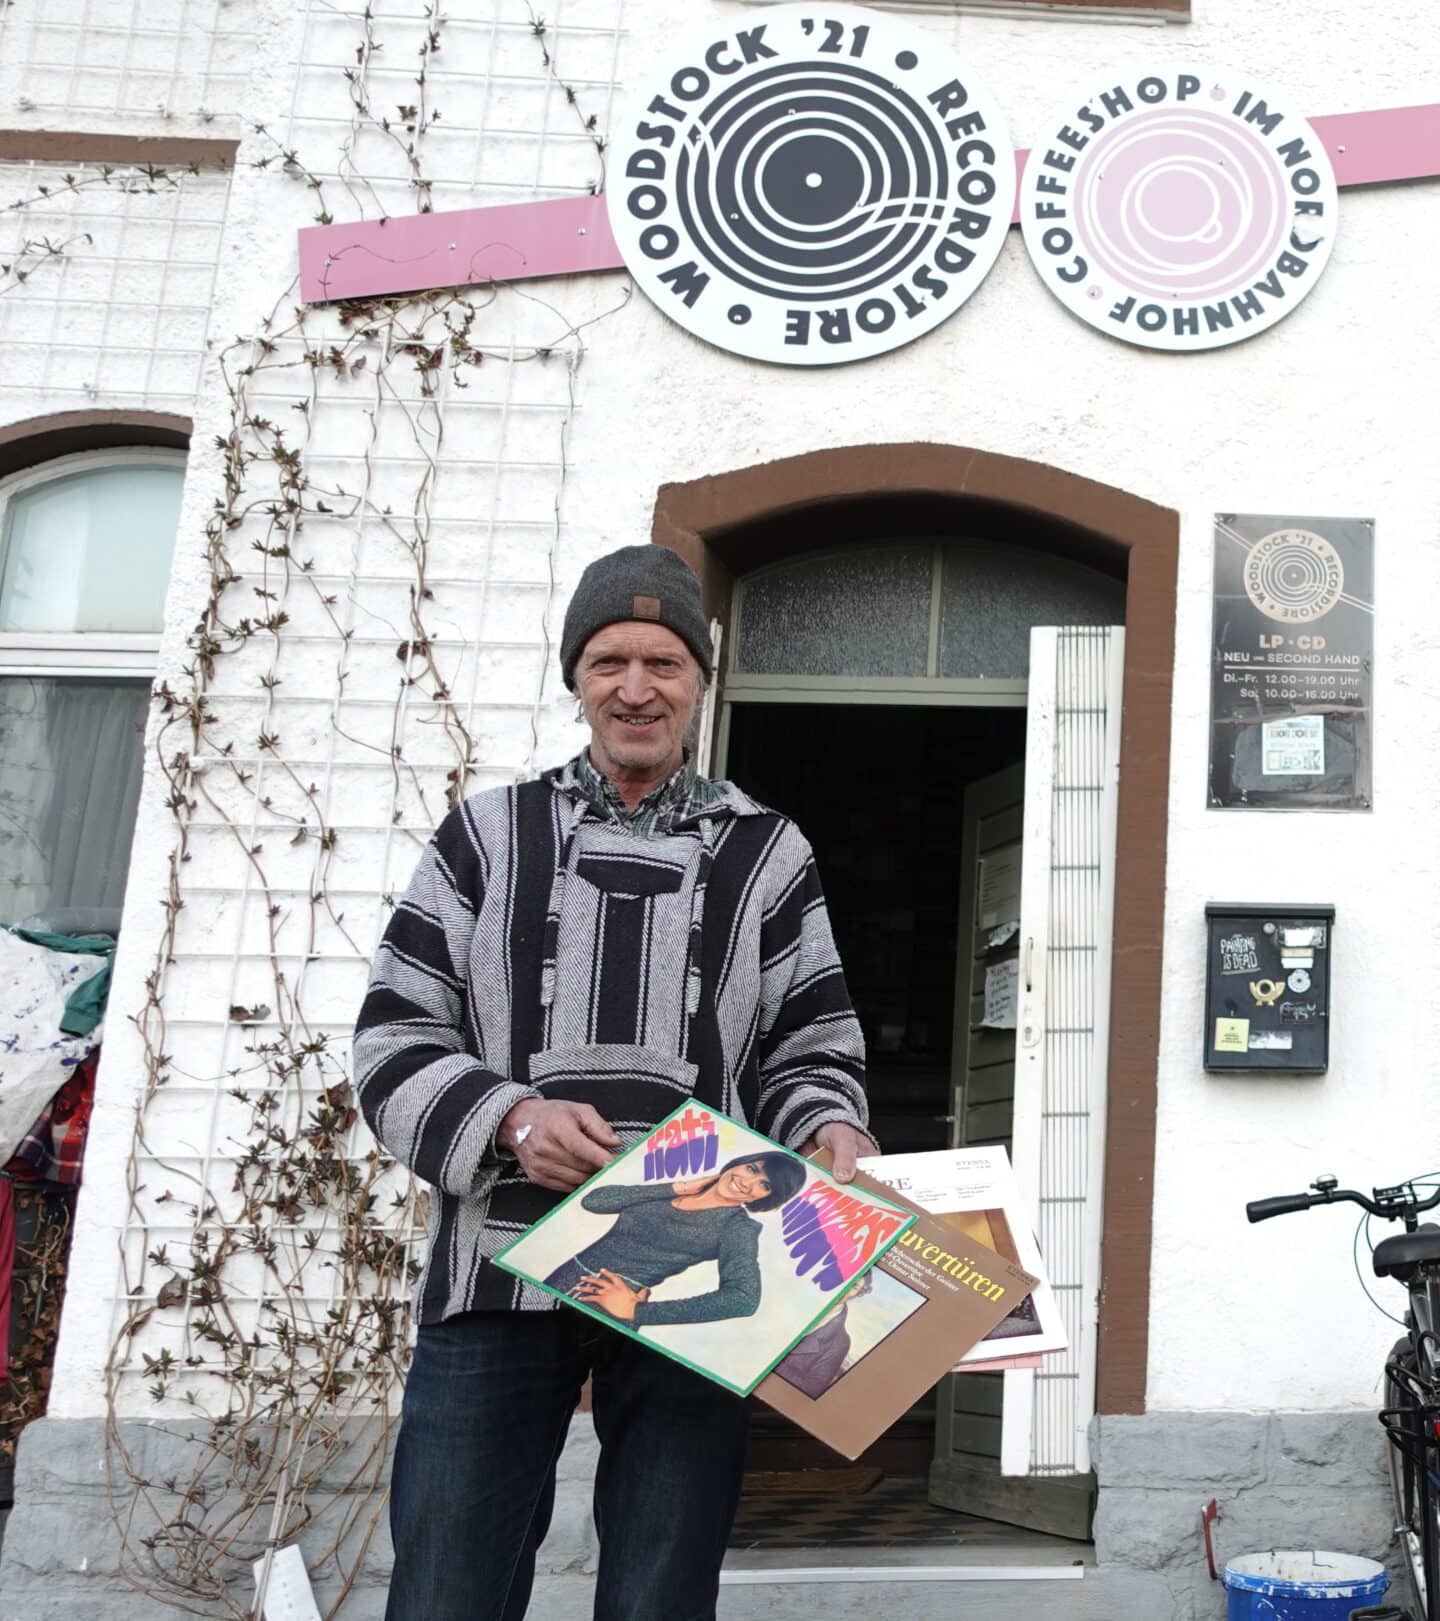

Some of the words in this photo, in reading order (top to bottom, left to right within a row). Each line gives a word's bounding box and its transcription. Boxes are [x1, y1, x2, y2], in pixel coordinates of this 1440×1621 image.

[1232, 90, 1285, 136] IM
[626, 24, 779, 309] WOODSTOCK
[801, 18, 871, 59] '21
[1035, 74, 1201, 284] COFFEESHOP
[784, 78, 997, 346] RECORDSTORE
[1249, 534, 1290, 605] WOODSTOCK
[1281, 555, 1339, 618] RECORDSTORE
[1224, 652, 1250, 662] NEU
[1267, 653, 1321, 664] SECOND
[1324, 655, 1360, 665] HAND
[1259, 634, 1284, 649] LP
[1297, 635, 1326, 650] CD
[1340, 675, 1360, 686] Uhr
[1233, 951, 1259, 969] DEAD
[900, 1229, 1006, 1303] uvertüren
